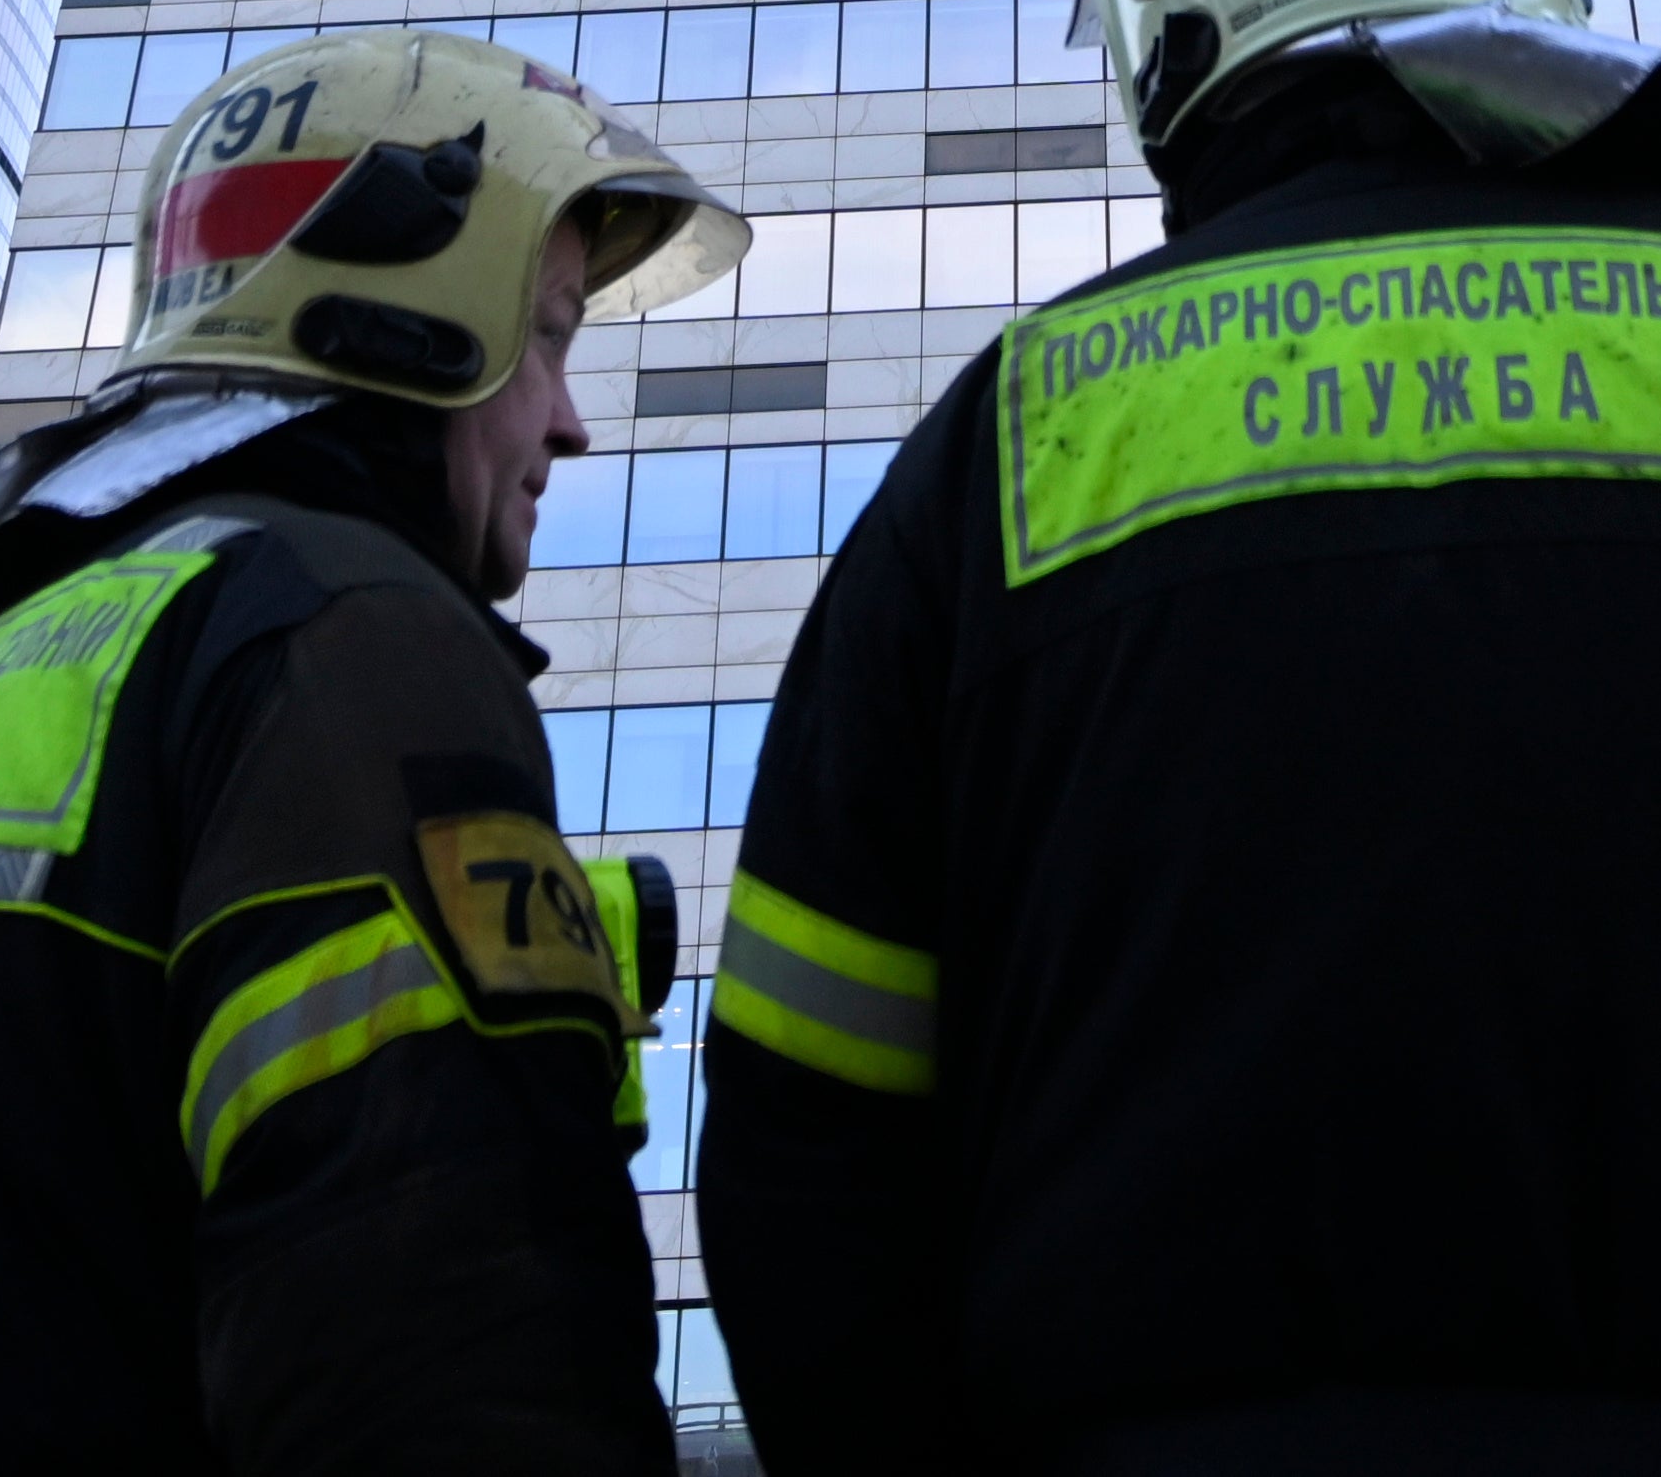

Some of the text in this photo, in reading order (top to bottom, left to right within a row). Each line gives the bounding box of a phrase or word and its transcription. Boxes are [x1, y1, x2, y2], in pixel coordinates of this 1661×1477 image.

[179, 80, 320, 172] 791
[1243, 351, 1599, 447] СЛУЖБА
[465, 859, 601, 957] 79
